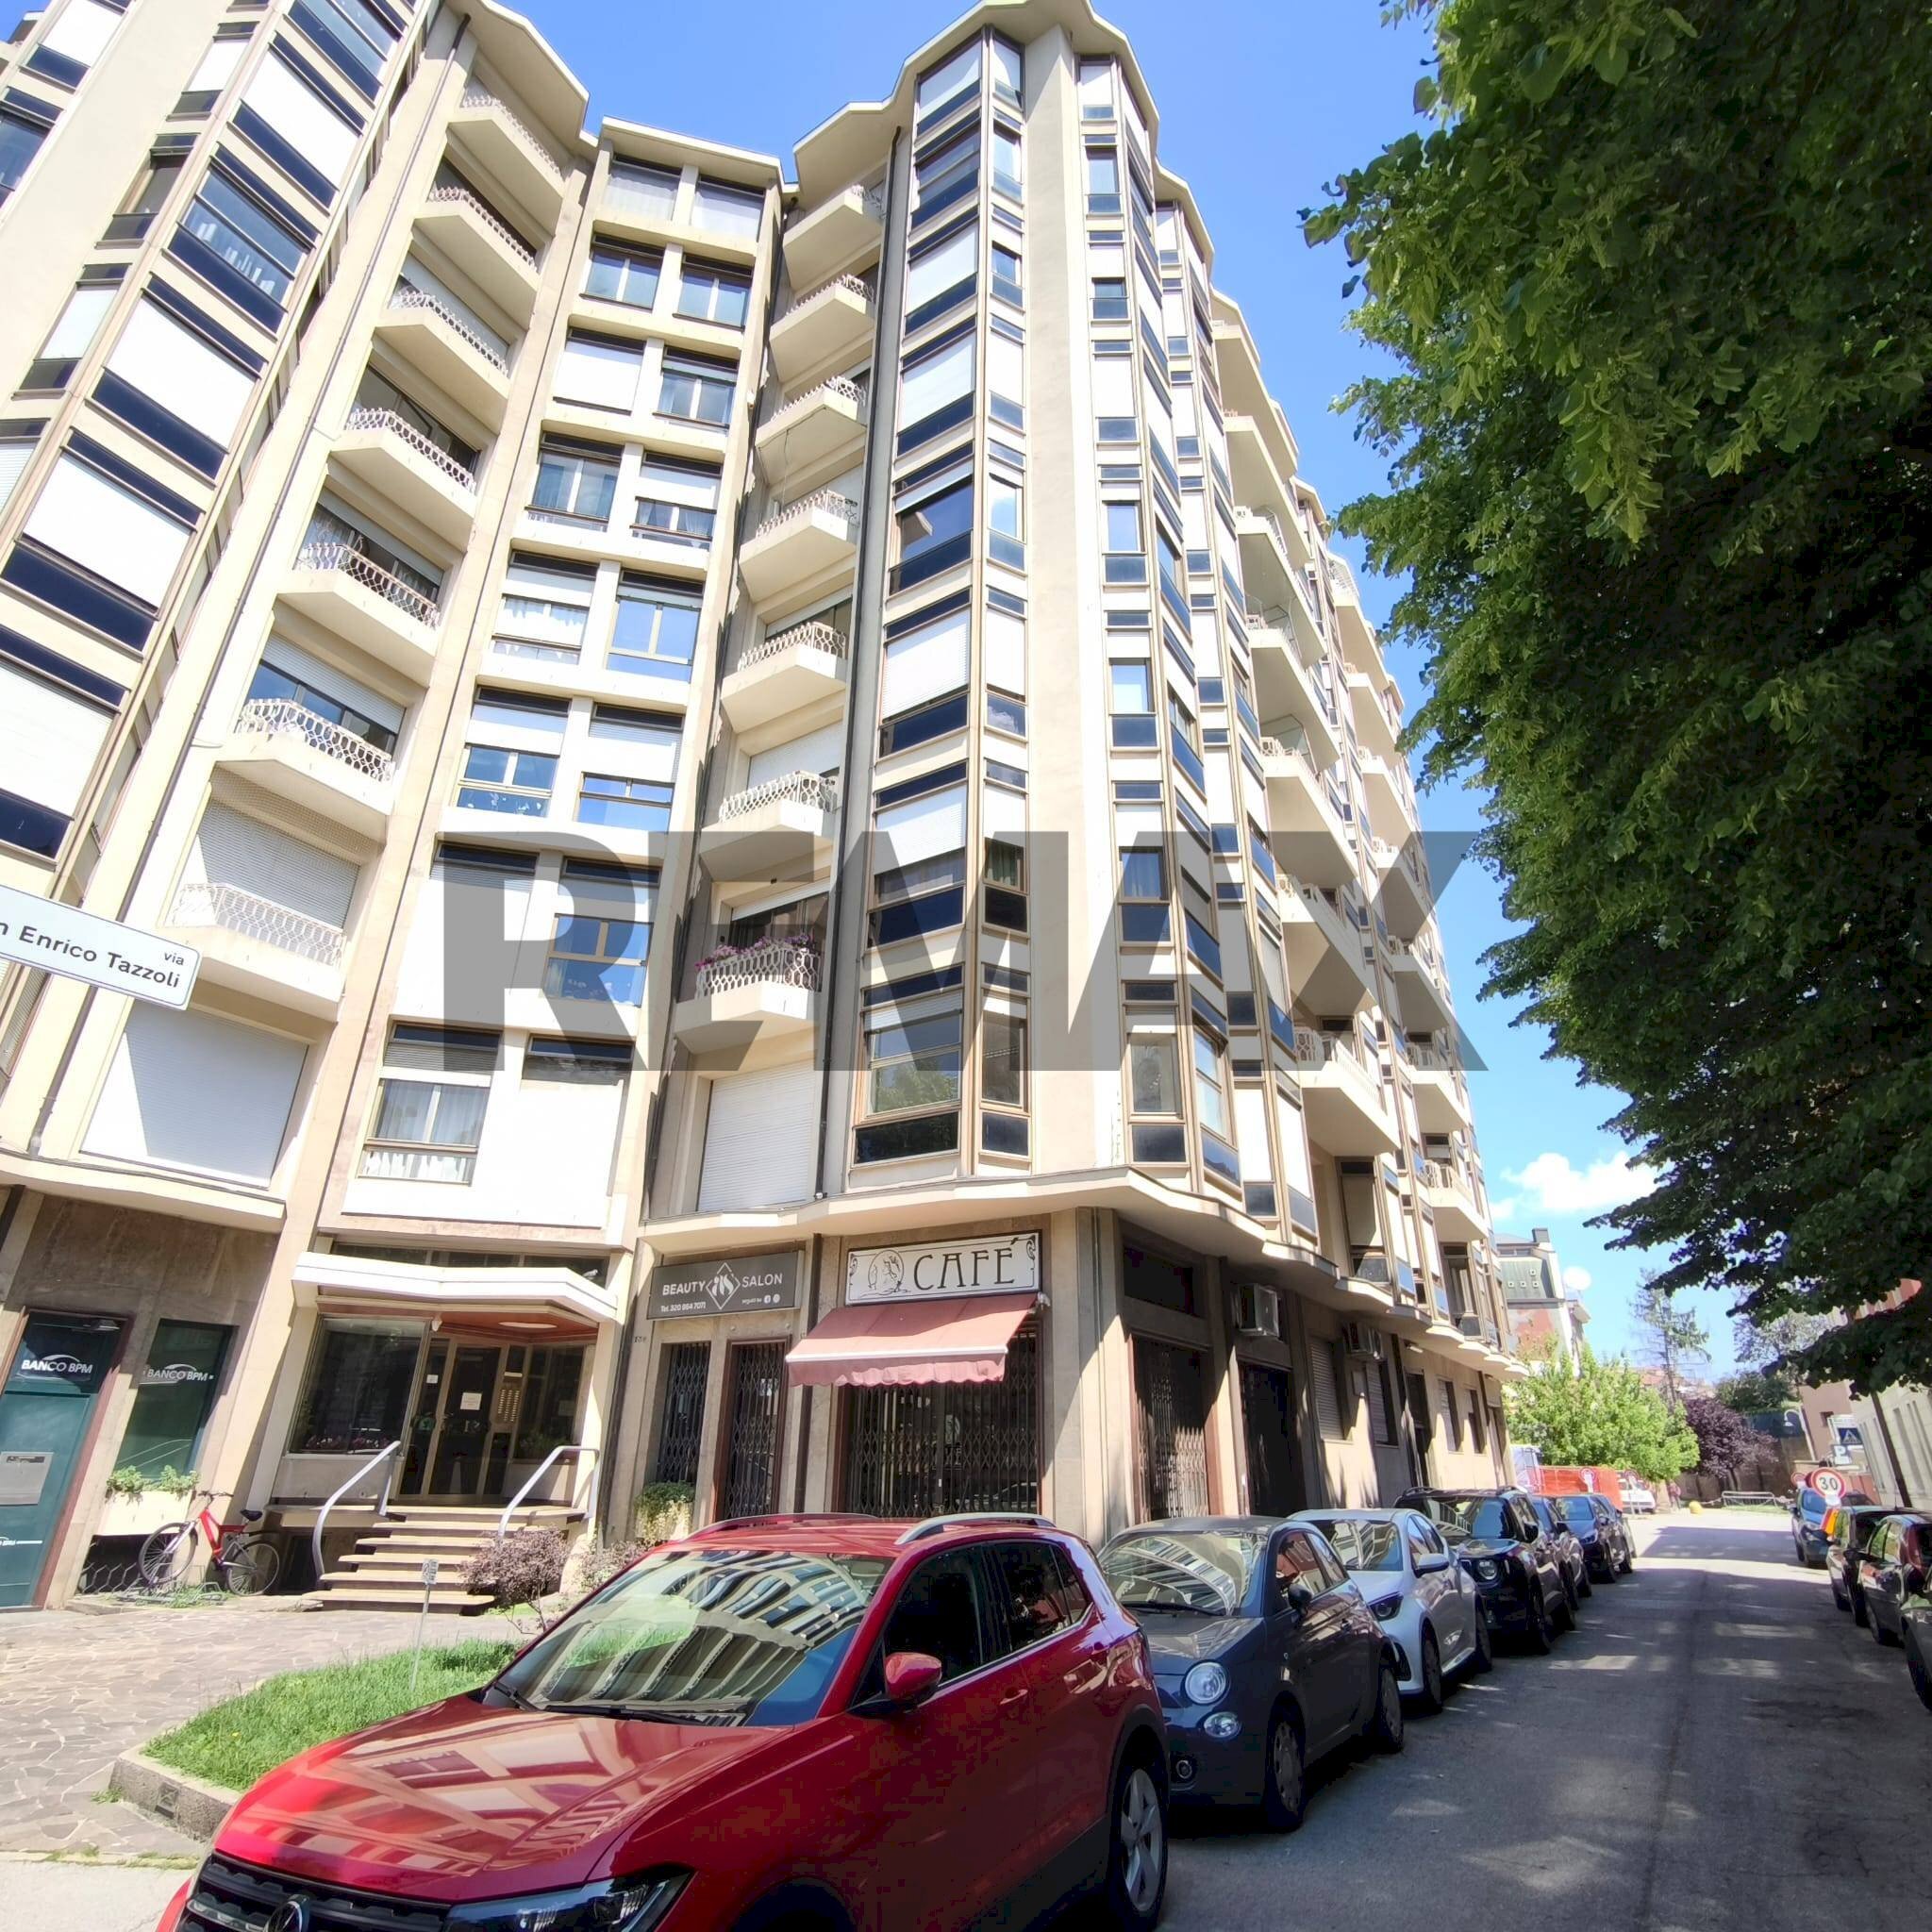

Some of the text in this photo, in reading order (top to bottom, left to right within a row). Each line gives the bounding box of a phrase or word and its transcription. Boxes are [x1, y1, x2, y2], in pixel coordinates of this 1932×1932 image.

[19, 925, 97, 961] Enrico
[108, 952, 182, 988] Tazzoli
[163, 951, 185, 966] via
[913, 1237, 1019, 1291] CAFÉ
[662, 1273, 783, 1296] BEAUTY SALON
[21, 1359, 92, 1374] BANCO BPM
[147, 1368, 208, 1381] BANCO BPM
[1819, 1476, 1839, 1491] 30
